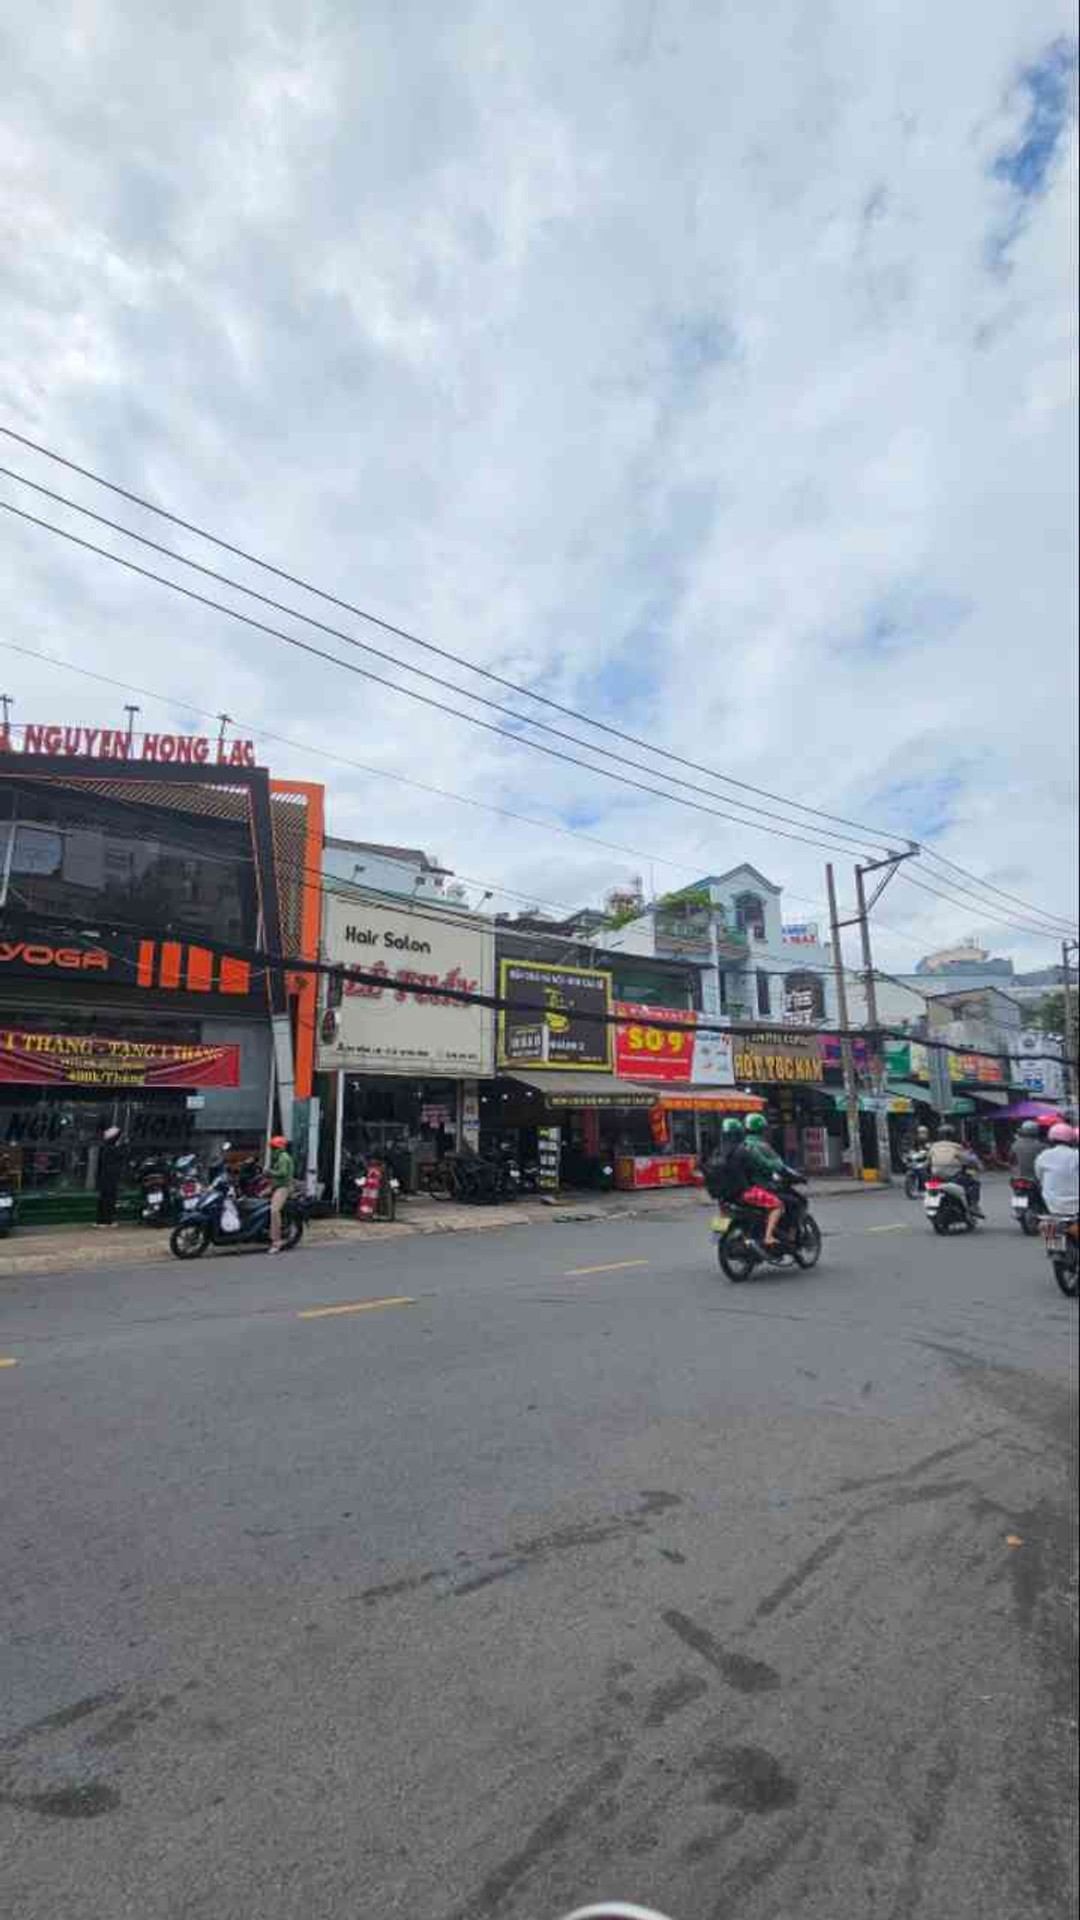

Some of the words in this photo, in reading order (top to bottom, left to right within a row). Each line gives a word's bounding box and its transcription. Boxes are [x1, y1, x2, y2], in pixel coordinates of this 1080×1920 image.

[345, 925, 379, 946] Hair
[383, 931, 431, 954] Salon
[0, 942, 109, 971] YOGA
